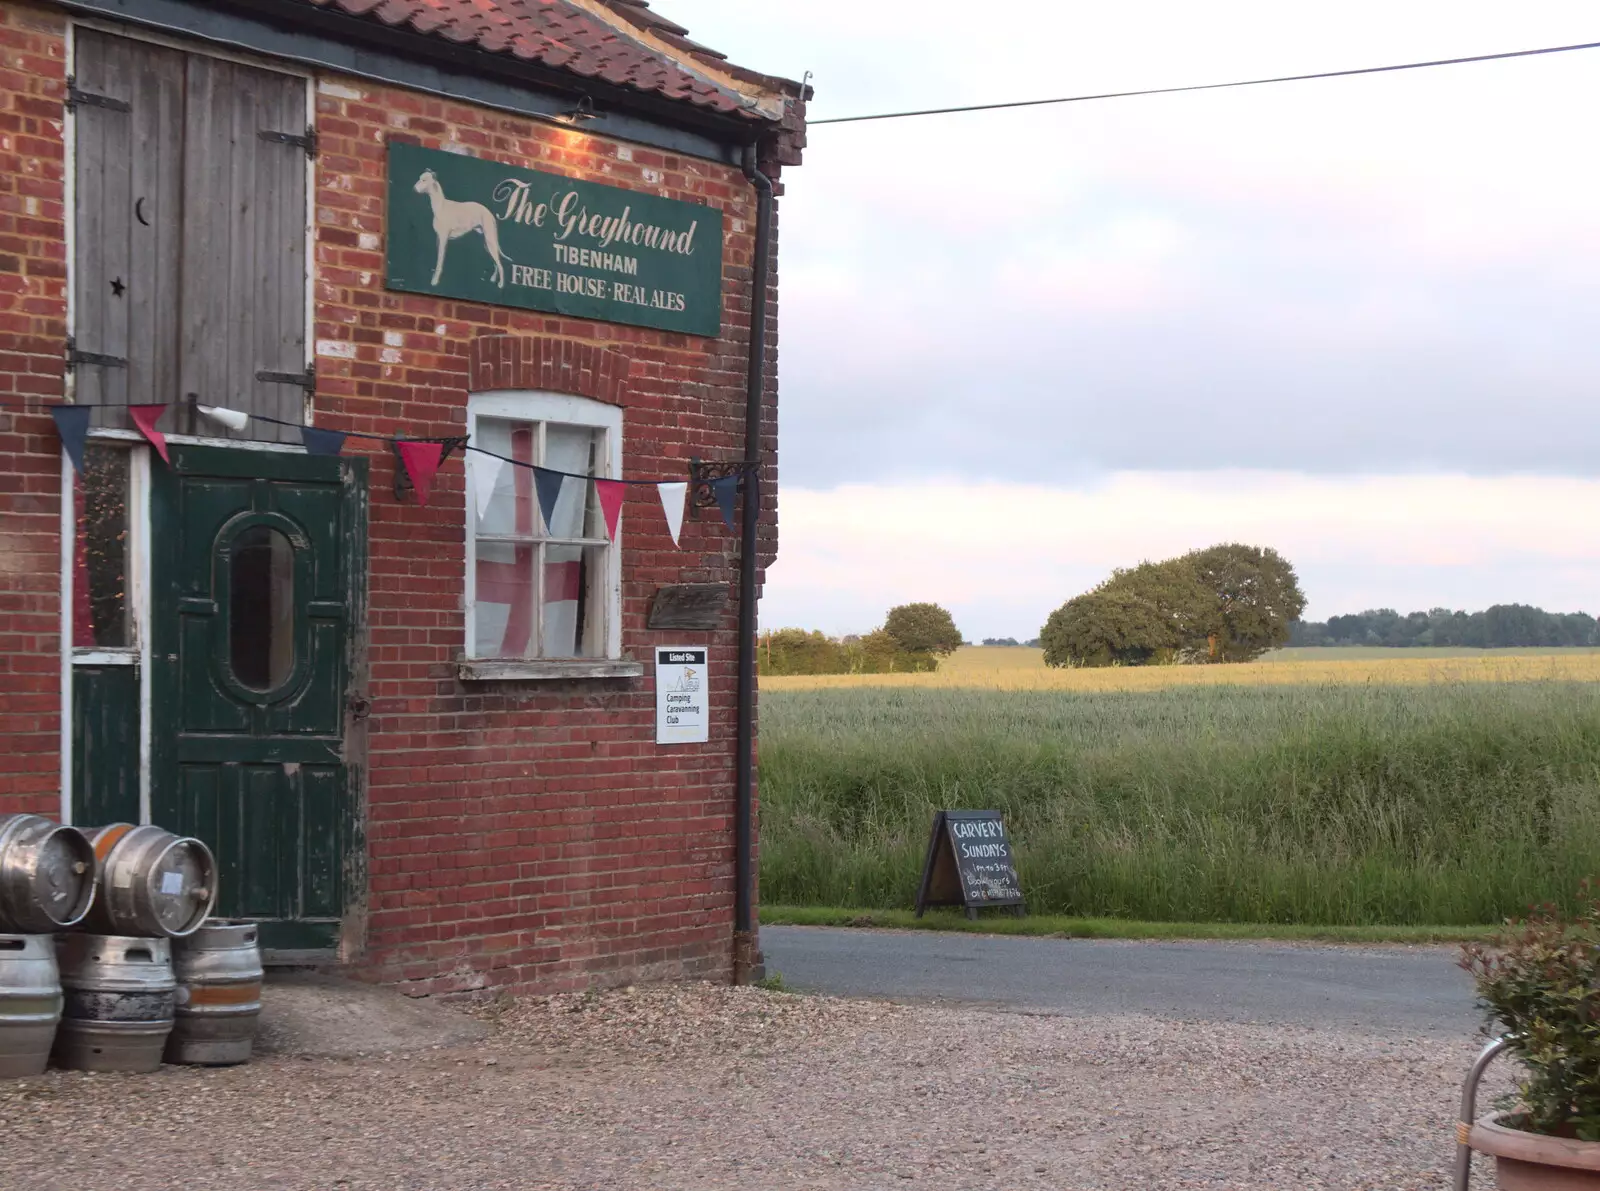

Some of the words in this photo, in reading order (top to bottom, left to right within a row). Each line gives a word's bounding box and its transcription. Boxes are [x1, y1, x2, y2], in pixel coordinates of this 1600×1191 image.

[492, 178, 547, 227] The
[549, 191, 697, 256] Greyhound
[553, 243, 637, 275] TIBENHAM
[511, 264, 552, 290] FREE
[613, 282, 649, 306] REAL
[649, 288, 685, 312] ALES
[669, 653, 685, 662] Listed
[685, 653, 696, 662] Site
[666, 694, 691, 703] Camping
[666, 705, 700, 714] Caravanning
[666, 715, 679, 724] Club
[953, 821, 1004, 838] CARVERY
[961, 843, 1007, 858] SUNDAYS
